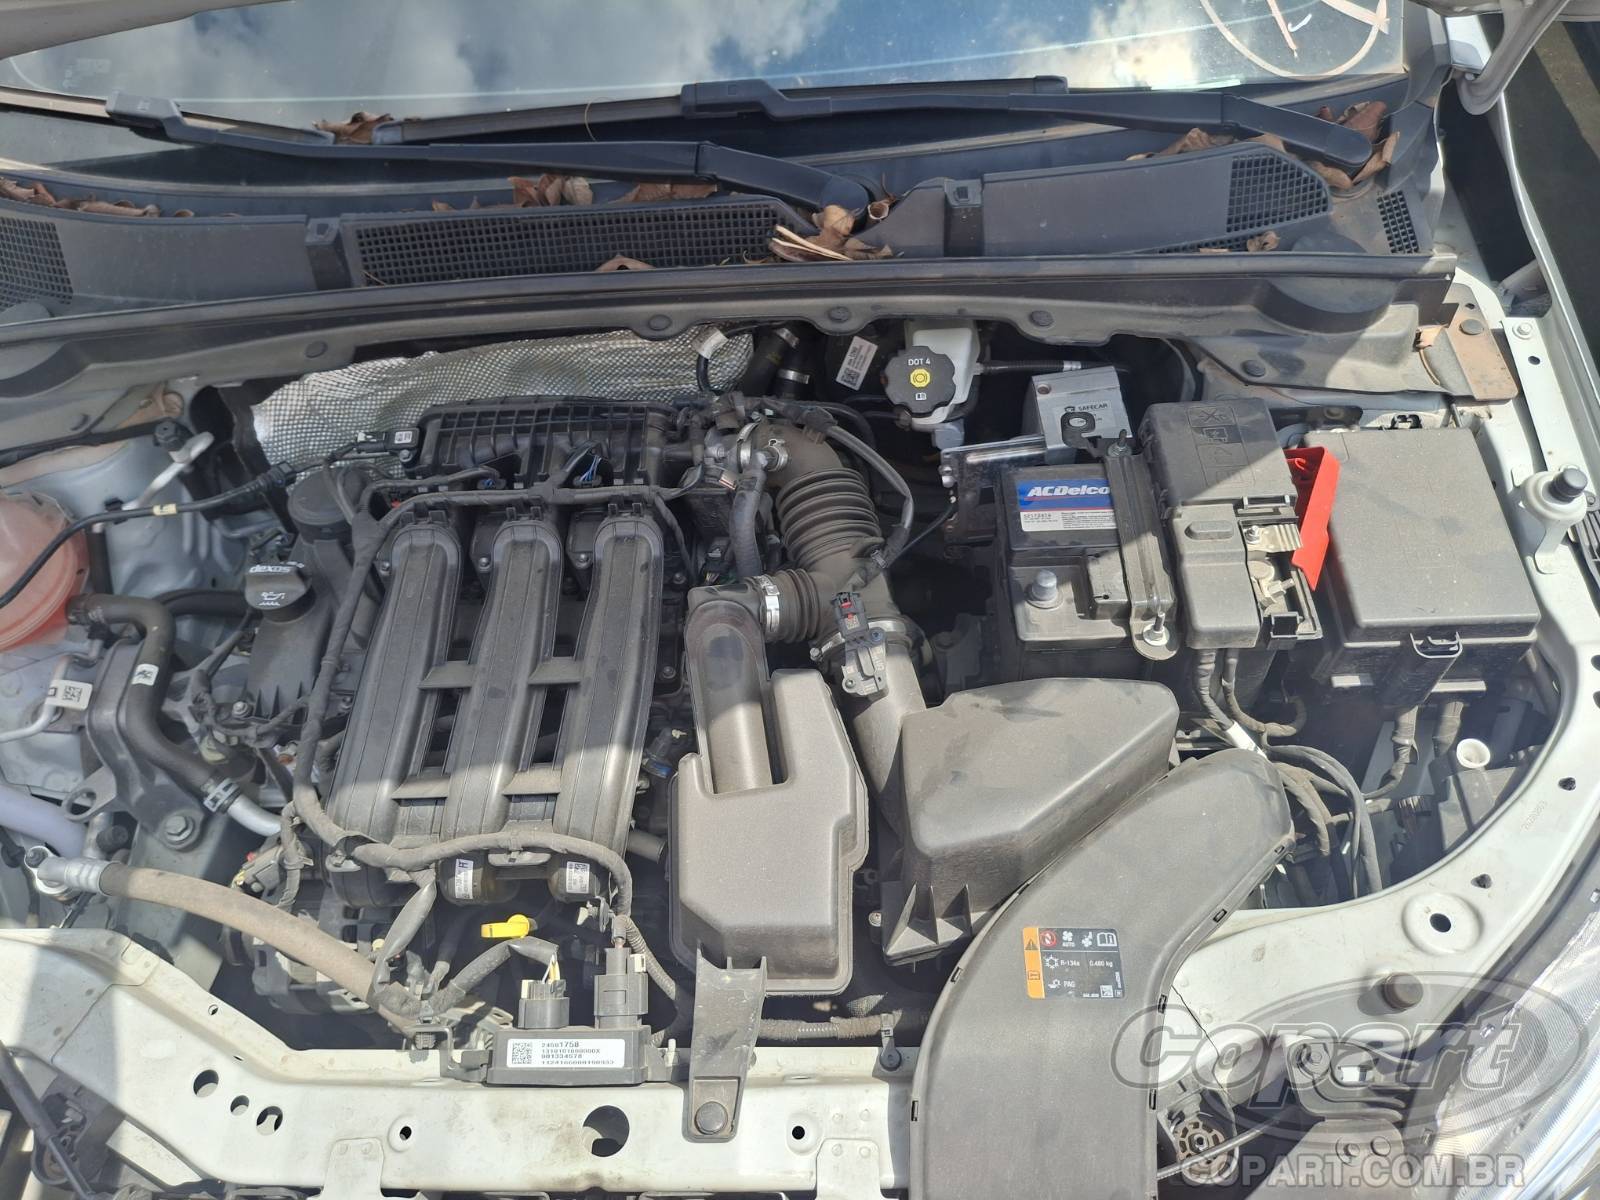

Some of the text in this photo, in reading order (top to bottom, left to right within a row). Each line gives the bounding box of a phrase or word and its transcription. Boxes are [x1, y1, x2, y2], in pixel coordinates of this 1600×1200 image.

[1078, 403, 1108, 411] SAFECAR
[1027, 485, 1110, 497] ACDelco
[249, 564, 291, 573] dexos
[1063, 980, 1076, 988] PAG
